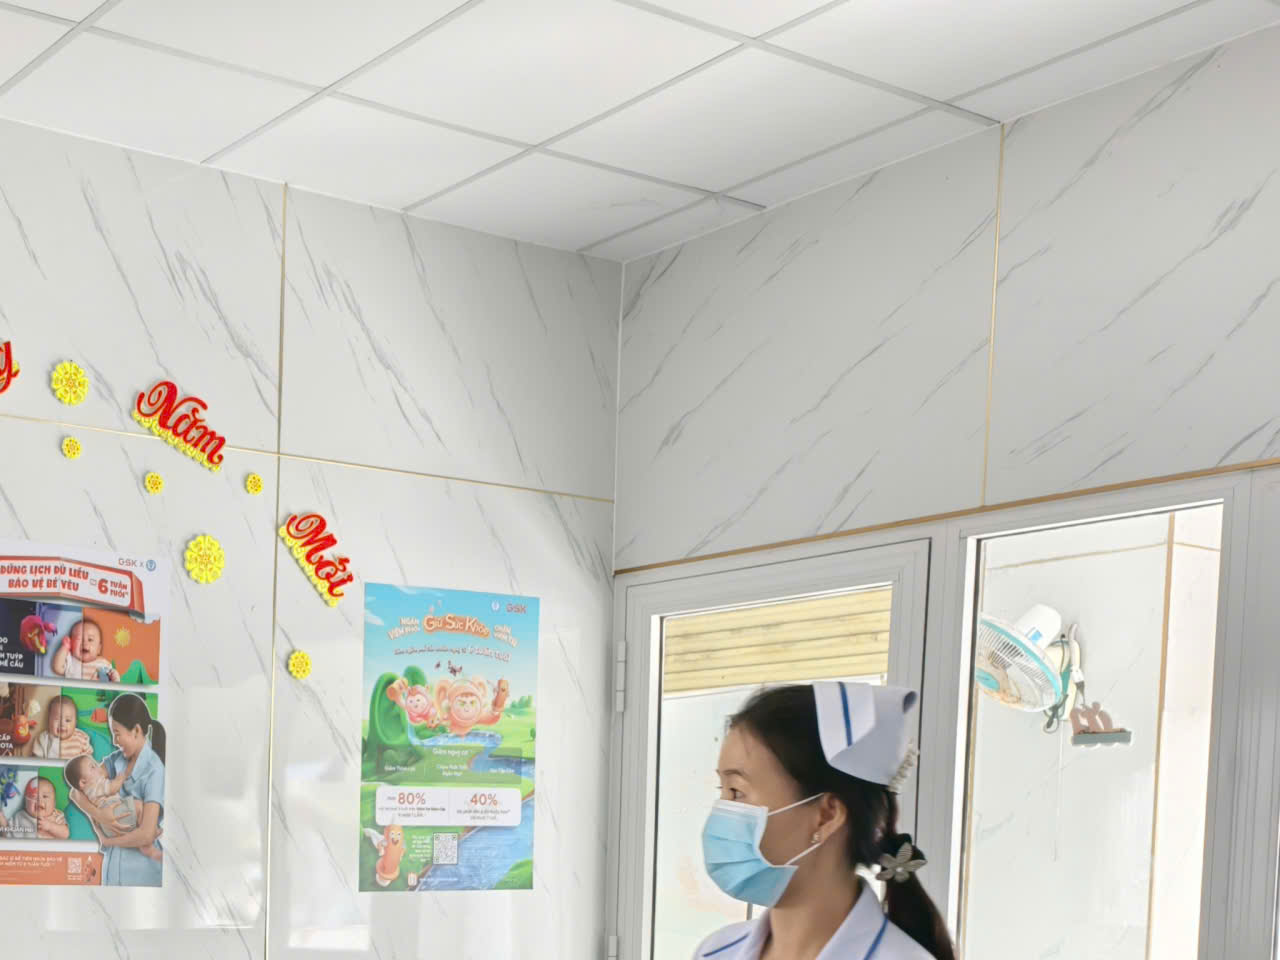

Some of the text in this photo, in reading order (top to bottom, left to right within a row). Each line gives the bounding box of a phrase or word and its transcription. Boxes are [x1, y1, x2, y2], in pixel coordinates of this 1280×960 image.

[136, 380, 226, 465] Năm
[118, 558, 137, 568] GSK
[97, 578, 109, 594] 6
[398, 792, 426, 805] 80%
[470, 793, 498, 806] 40%
